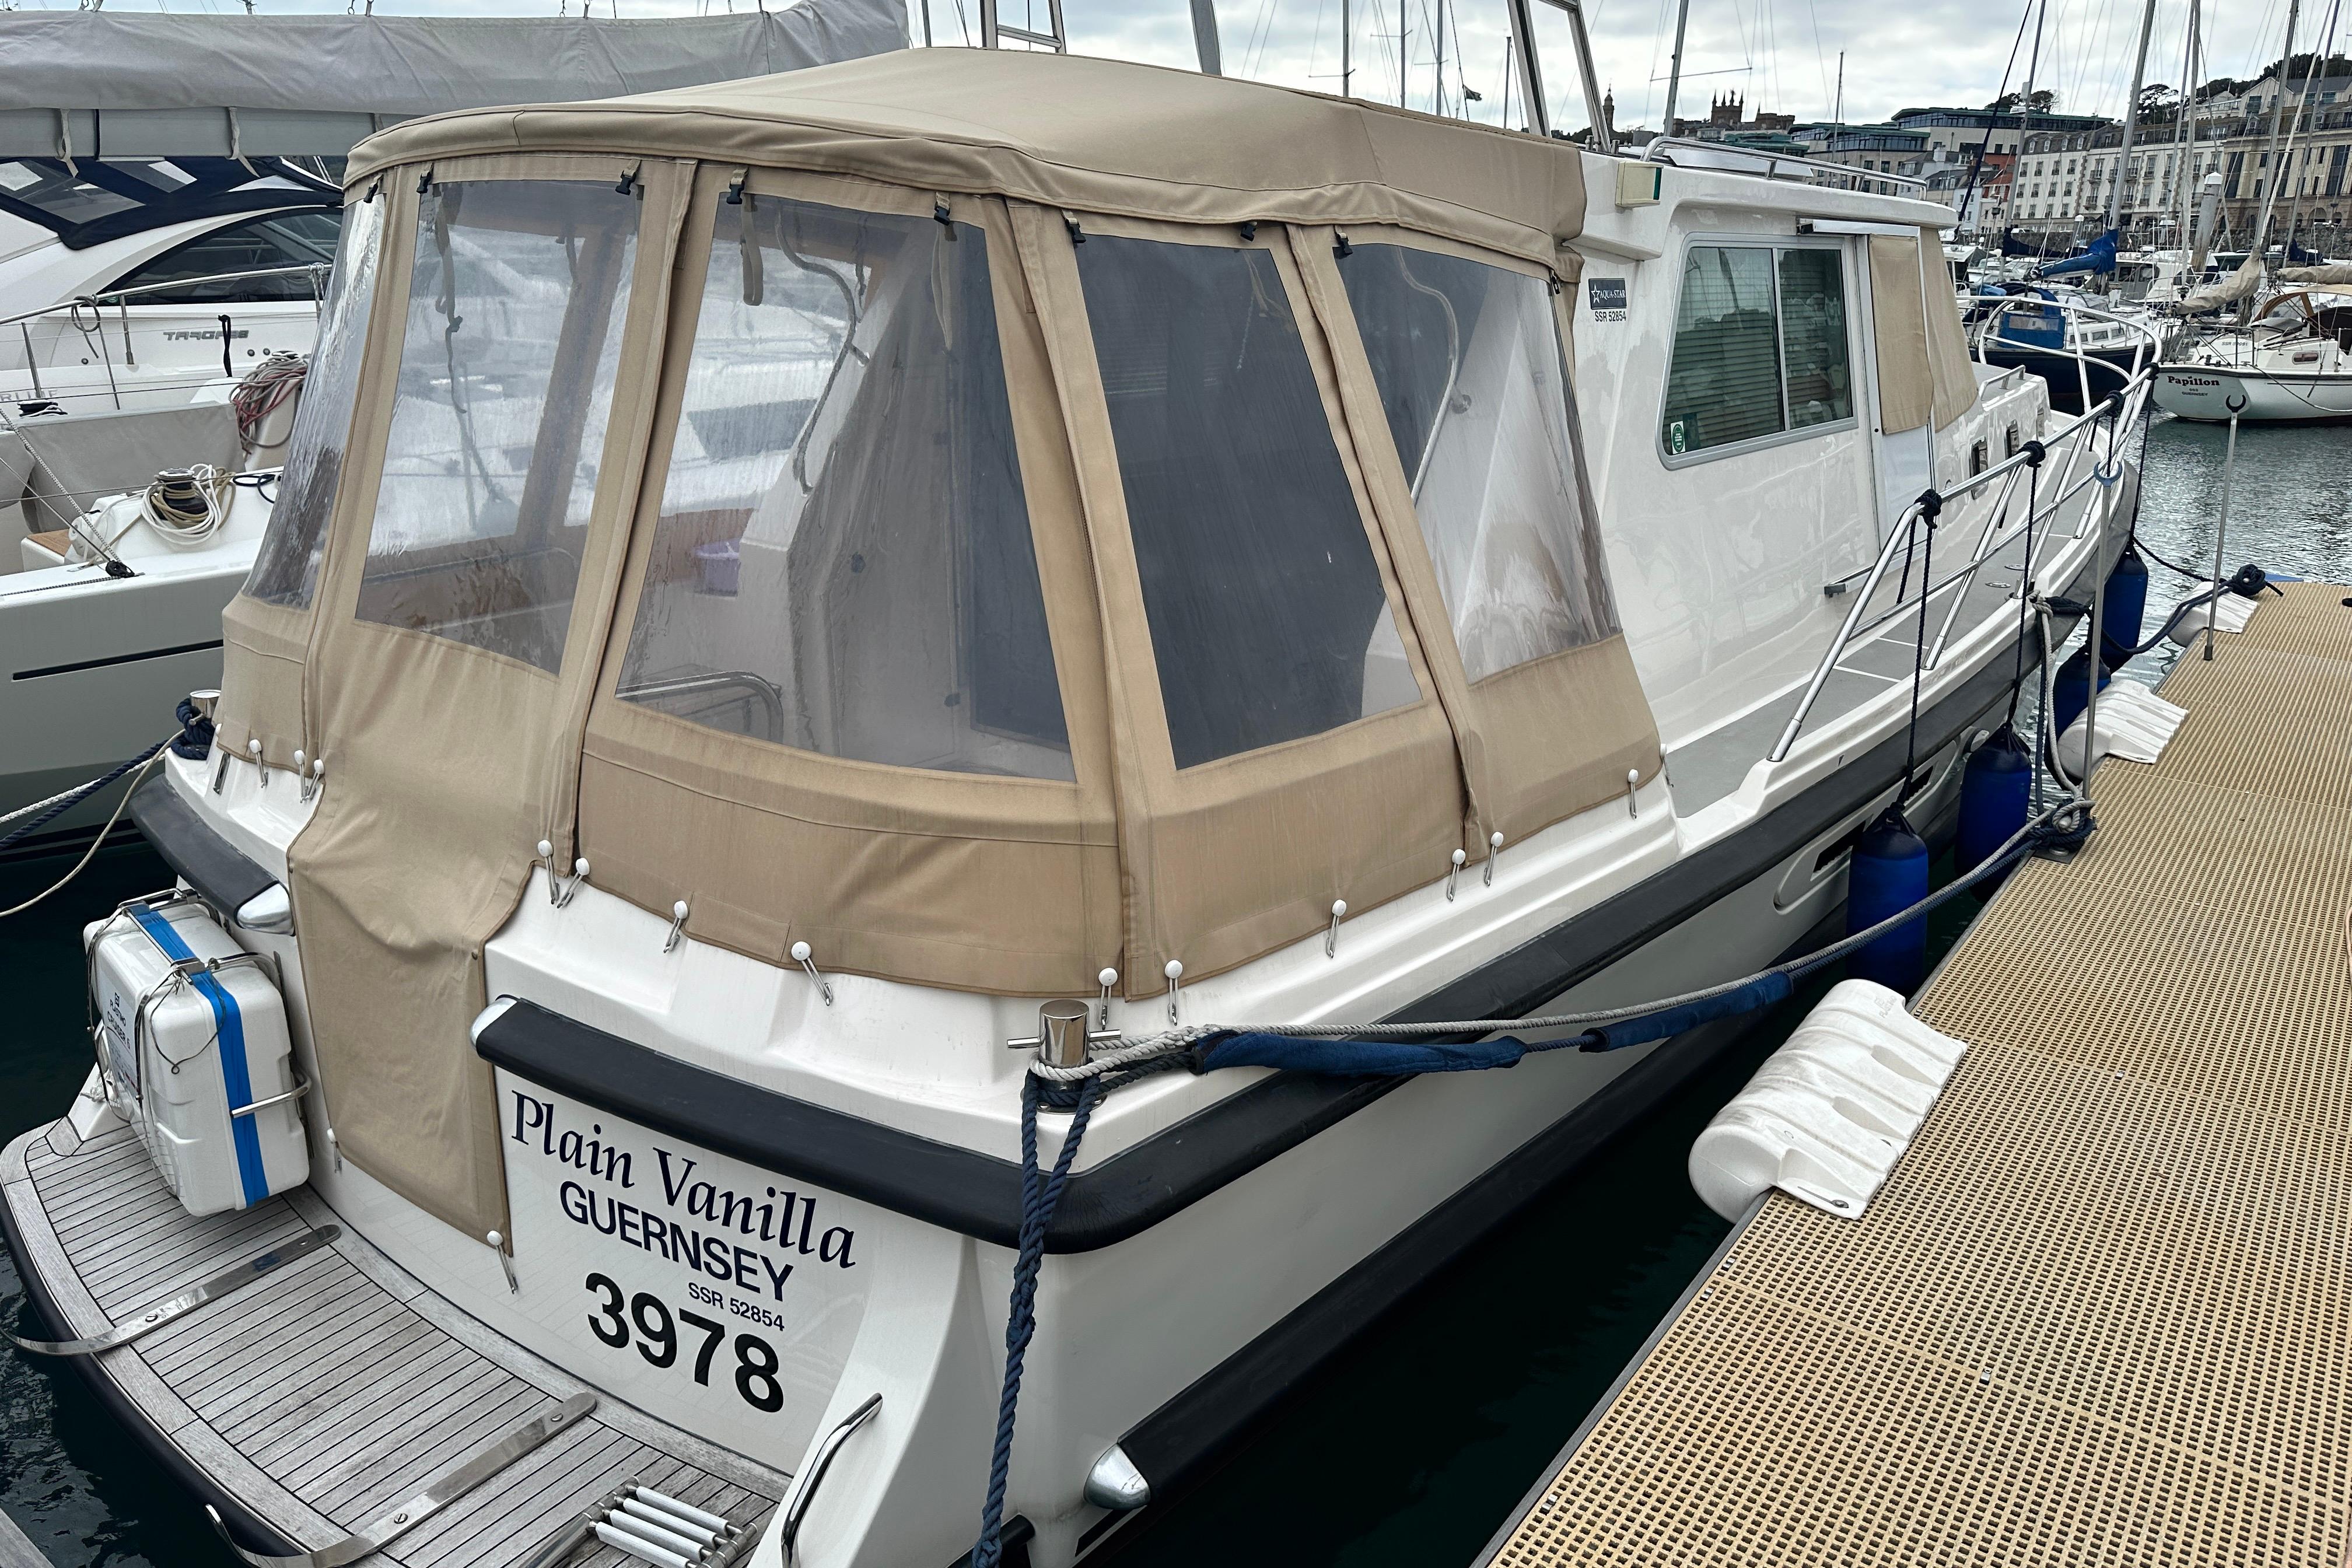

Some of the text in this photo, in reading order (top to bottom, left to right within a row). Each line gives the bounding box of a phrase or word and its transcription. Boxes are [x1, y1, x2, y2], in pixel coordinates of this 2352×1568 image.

[1595, 311, 1626, 322] SSR 52854
[1600, 289, 1626, 300] AQUA-STAR
[2167, 376, 2220, 386] Papillon
[512, 1090, 856, 1268] Plain Vanilla
[560, 1181, 793, 1301] GUERNSEY
[688, 1282, 785, 1332] SSR 52854
[586, 1272, 784, 1413] 3978
